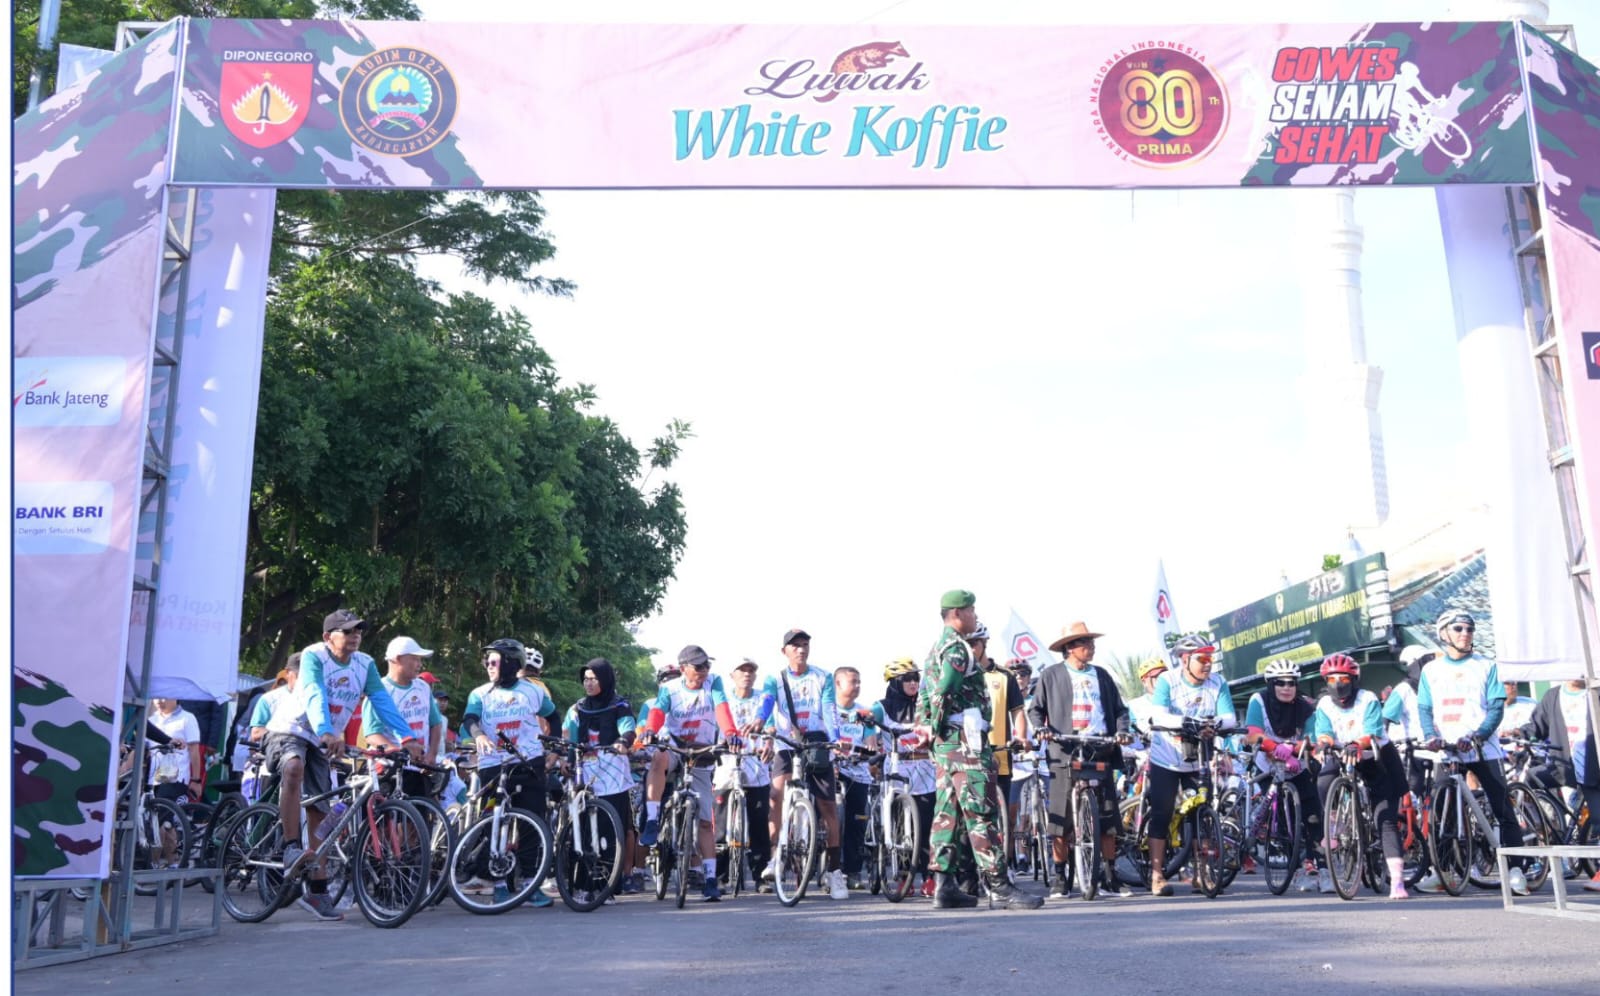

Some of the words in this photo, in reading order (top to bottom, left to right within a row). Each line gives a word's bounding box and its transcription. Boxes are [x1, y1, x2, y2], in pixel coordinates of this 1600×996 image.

[223, 49, 314, 62] DIPONEGORO
[355, 48, 400, 77] KODIM
[408, 50, 445, 76] 0727
[1131, 40, 1206, 63] INDONESIA
[1271, 46, 1400, 83] GOWES
[743, 59, 932, 99] Luwak
[1089, 48, 1128, 103] NASIONAL
[1118, 68, 1204, 138] 80
[1269, 83, 1397, 123] SENAM
[355, 125, 440, 154] KARANGANYAR
[672, 103, 832, 161] White
[842, 104, 1008, 169] Koffie
[1090, 110, 1129, 162] TENTARA
[1137, 143, 1193, 155] PRIMA
[1273, 125, 1390, 164] SEHAT
[25, 391, 61, 406] Bank
[62, 390, 109, 408] Jateng
[15, 506, 67, 519] BANK
[72, 506, 104, 518] BRI
